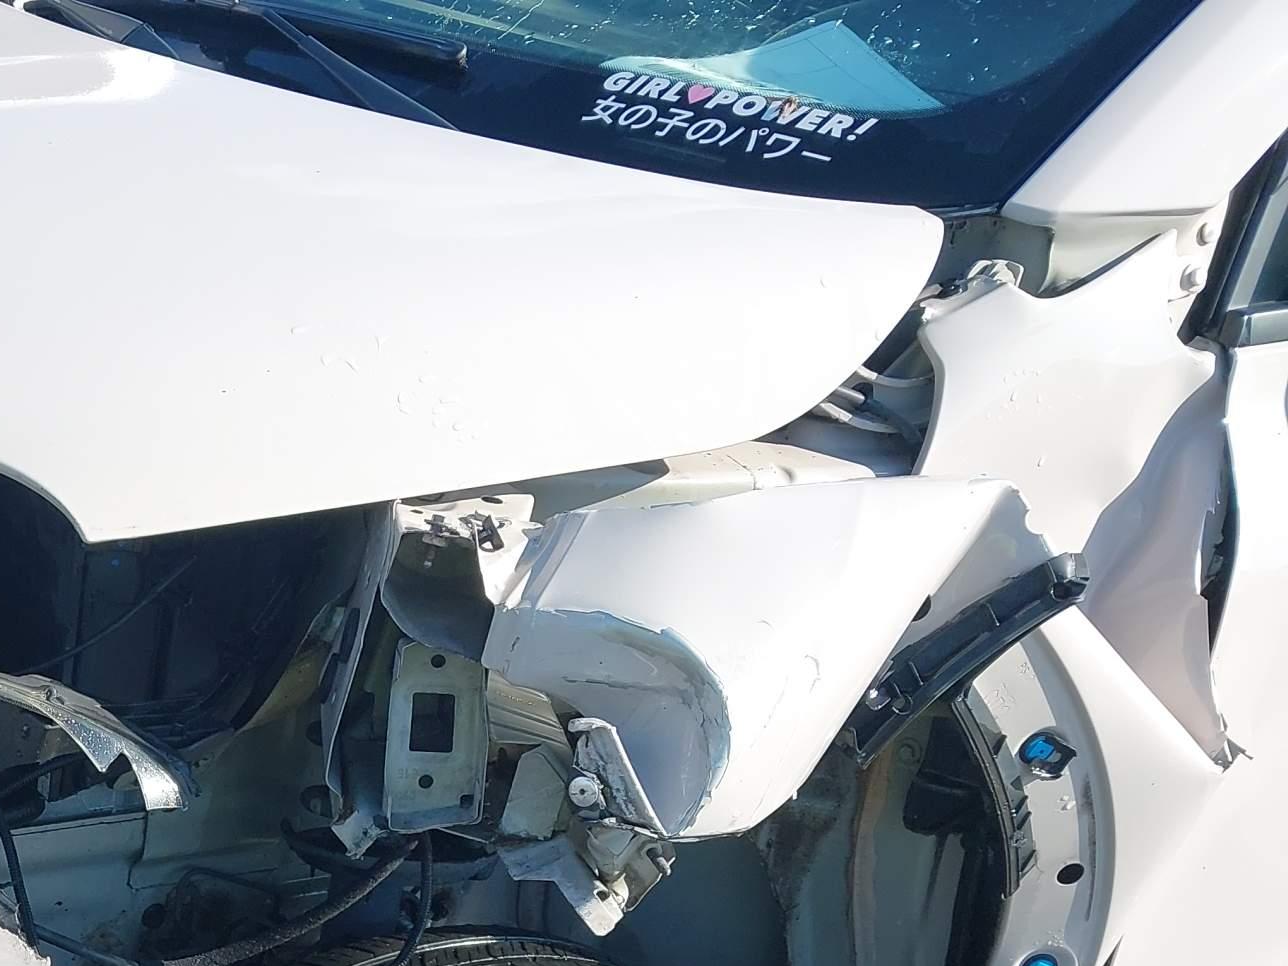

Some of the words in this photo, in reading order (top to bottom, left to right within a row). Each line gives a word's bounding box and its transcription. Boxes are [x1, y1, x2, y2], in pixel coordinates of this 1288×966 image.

[581, 94, 833, 162] 女の子のパワー
[602, 71, 684, 103] GIRL
[704, 89, 880, 141] POWER!
